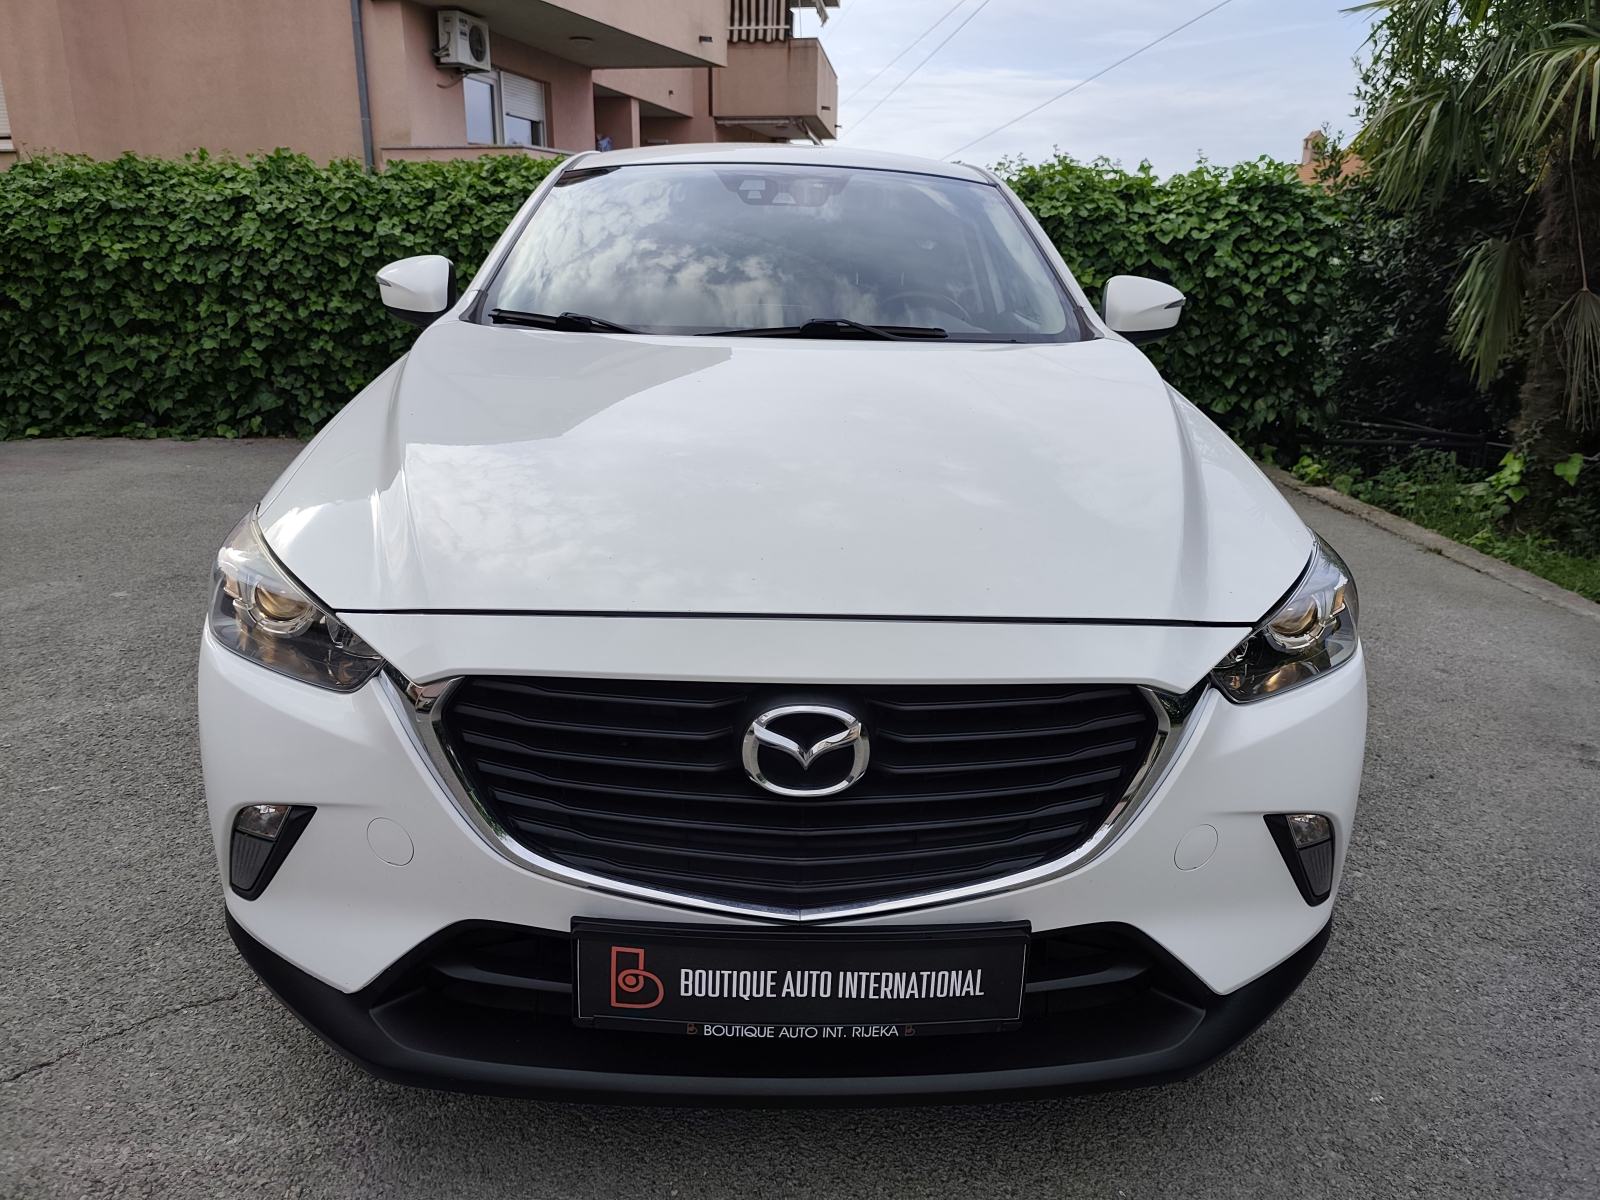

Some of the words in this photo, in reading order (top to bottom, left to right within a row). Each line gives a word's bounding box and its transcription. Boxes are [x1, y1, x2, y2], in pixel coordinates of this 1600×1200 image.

[680, 968, 778, 1001] BOUTIQUE
[781, 970, 832, 998] AUTO
[837, 968, 985, 999] INTERNATIONAL
[703, 1024, 775, 1038] BOUTIQUE
[778, 1026, 819, 1039] AUTO
[822, 1026, 847, 1038] INT.
[851, 1025, 899, 1038] RIJEKA
